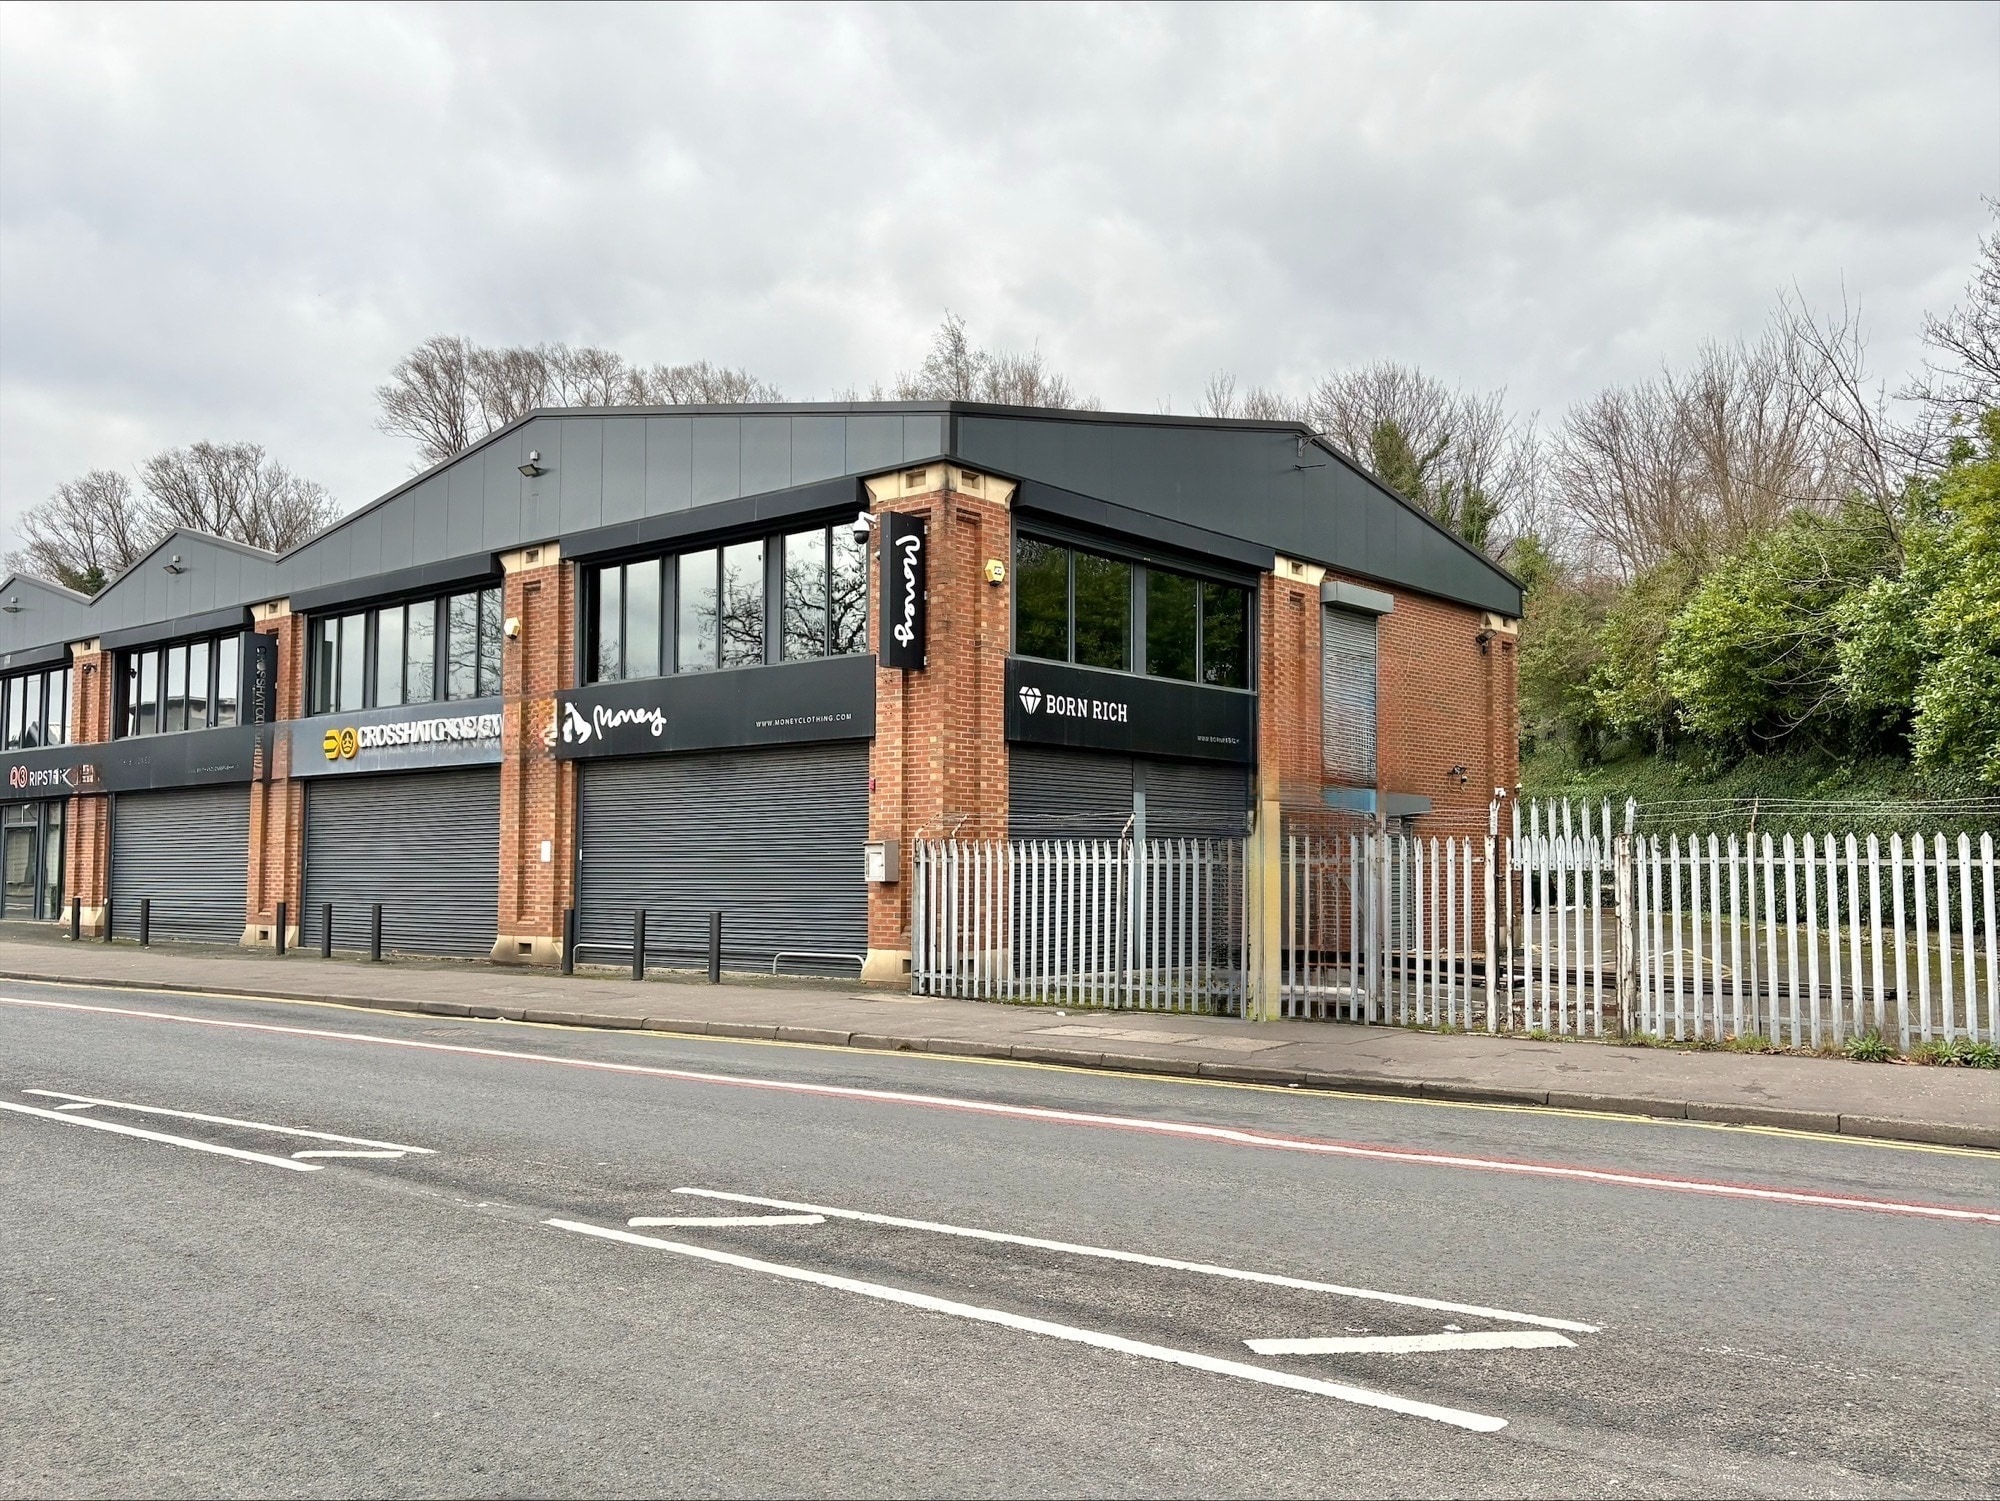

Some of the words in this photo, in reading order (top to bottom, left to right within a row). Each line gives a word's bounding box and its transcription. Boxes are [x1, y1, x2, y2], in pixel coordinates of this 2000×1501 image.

[894, 535, 921, 648] Money
[593, 704, 667, 740] Money
[755, 713, 852, 728] WWW.MONEYCLOTHING.COM
[1046, 694, 1088, 718] BORN
[1092, 700, 1128, 722] RICH
